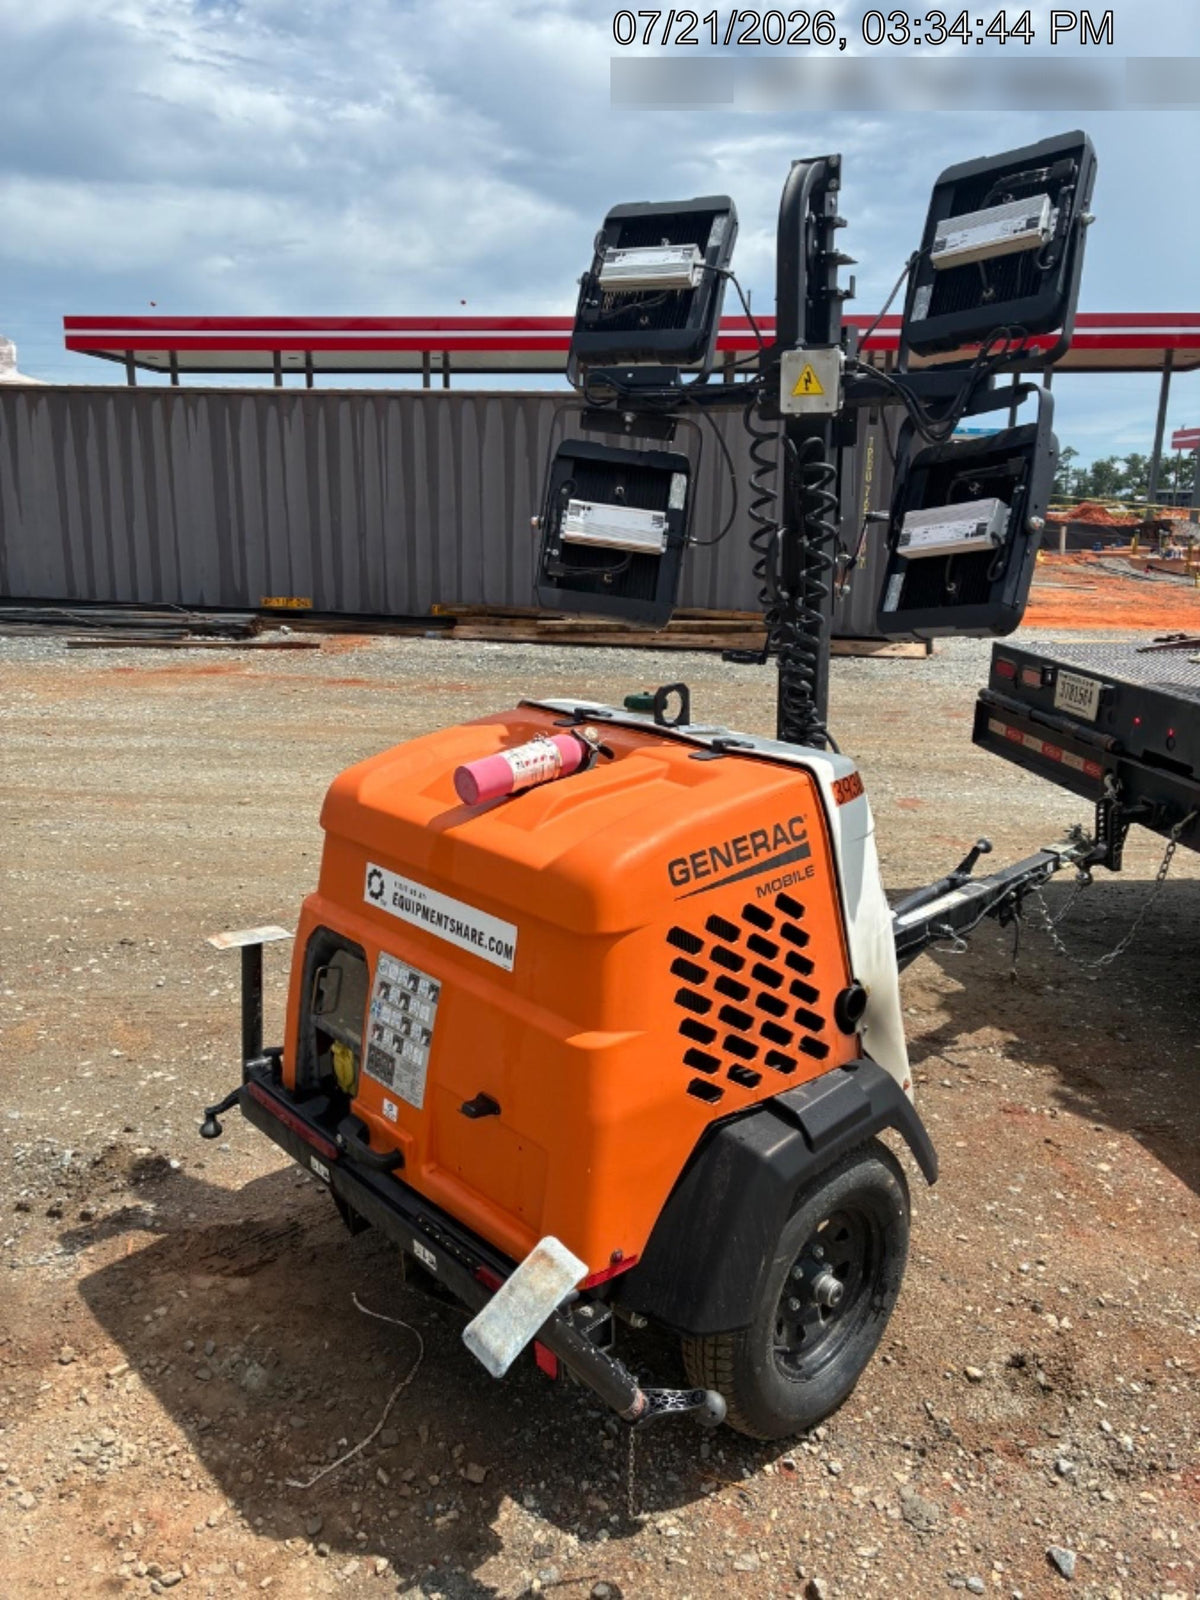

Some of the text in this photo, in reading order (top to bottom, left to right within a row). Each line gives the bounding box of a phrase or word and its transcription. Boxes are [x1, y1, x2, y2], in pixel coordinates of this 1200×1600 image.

[668, 815, 807, 887] GENERAC
[756, 865, 815, 898] MOBILE
[392, 892, 513, 961] EQUIPMENTSHARE.COM
